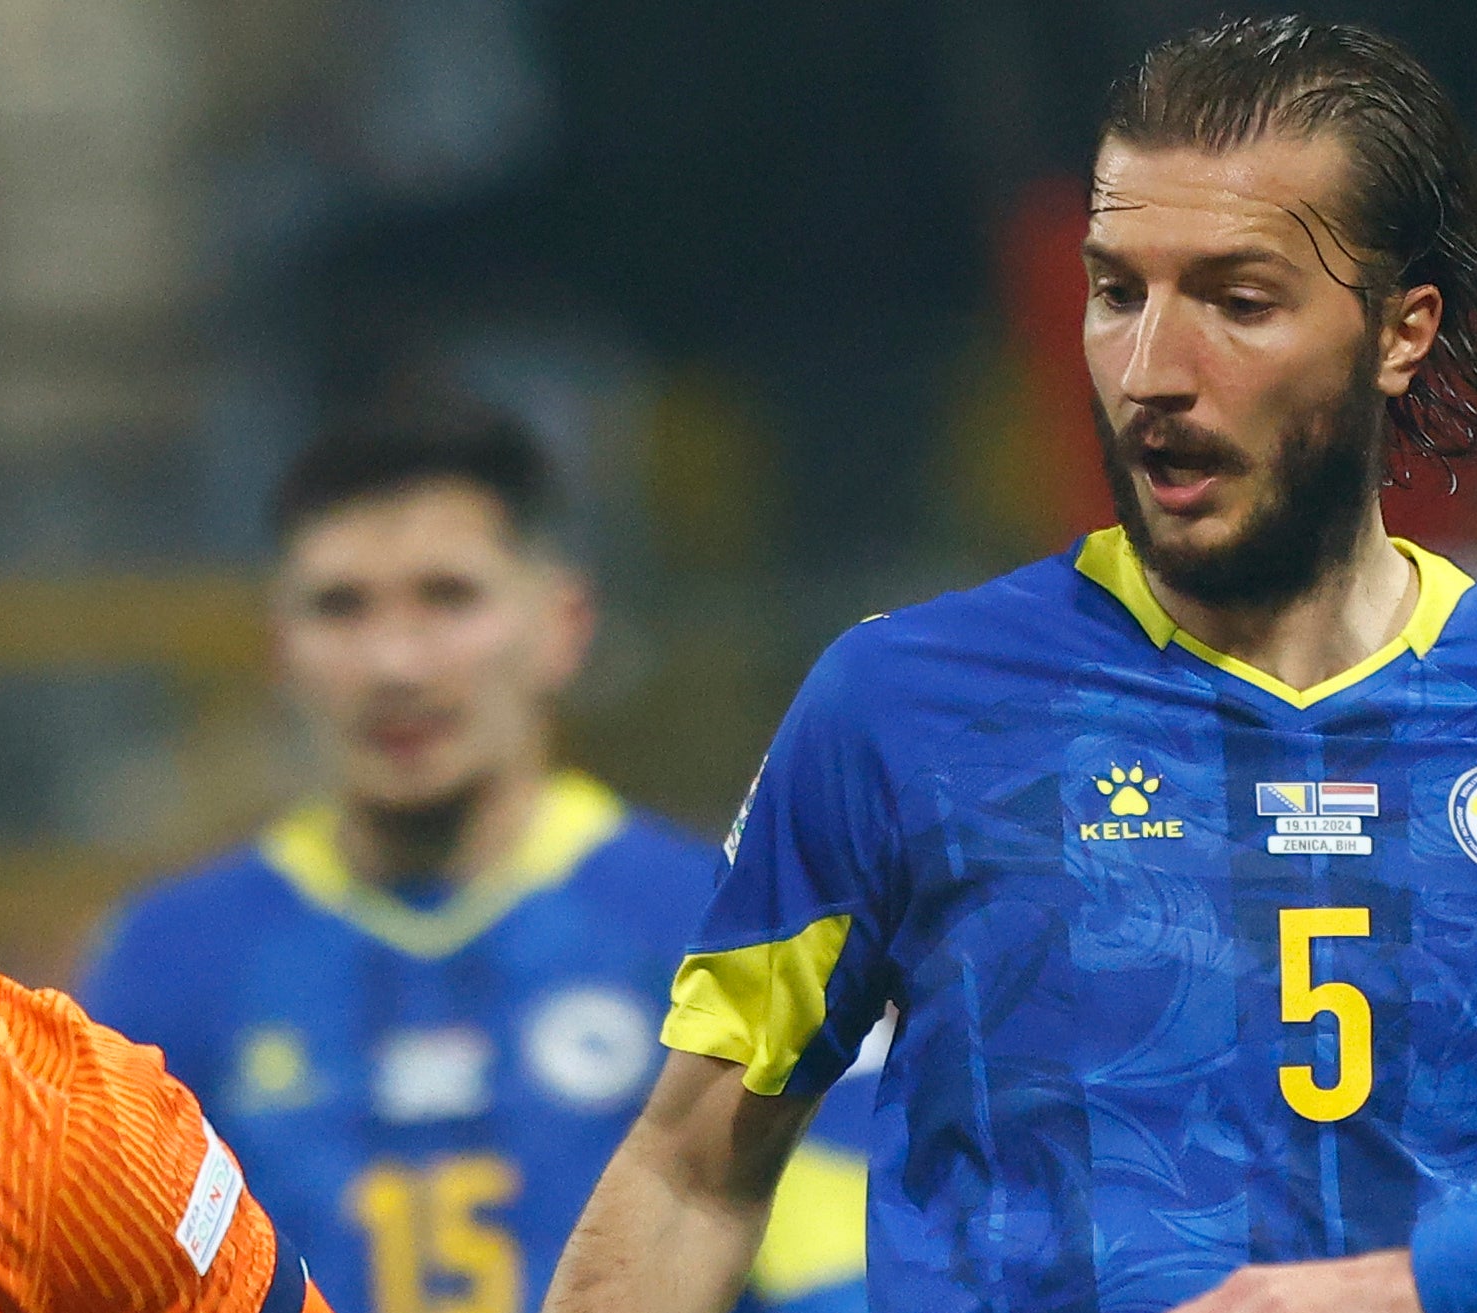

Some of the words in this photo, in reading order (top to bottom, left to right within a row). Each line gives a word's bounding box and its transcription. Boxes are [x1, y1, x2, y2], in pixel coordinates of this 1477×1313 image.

[1080, 821, 1184, 841] KELME
[1285, 820, 1353, 831] 19.11.2024
[1283, 839, 1333, 853] ZENICA,
[1336, 840, 1357, 852] BiH
[1278, 907, 1373, 1123] 5
